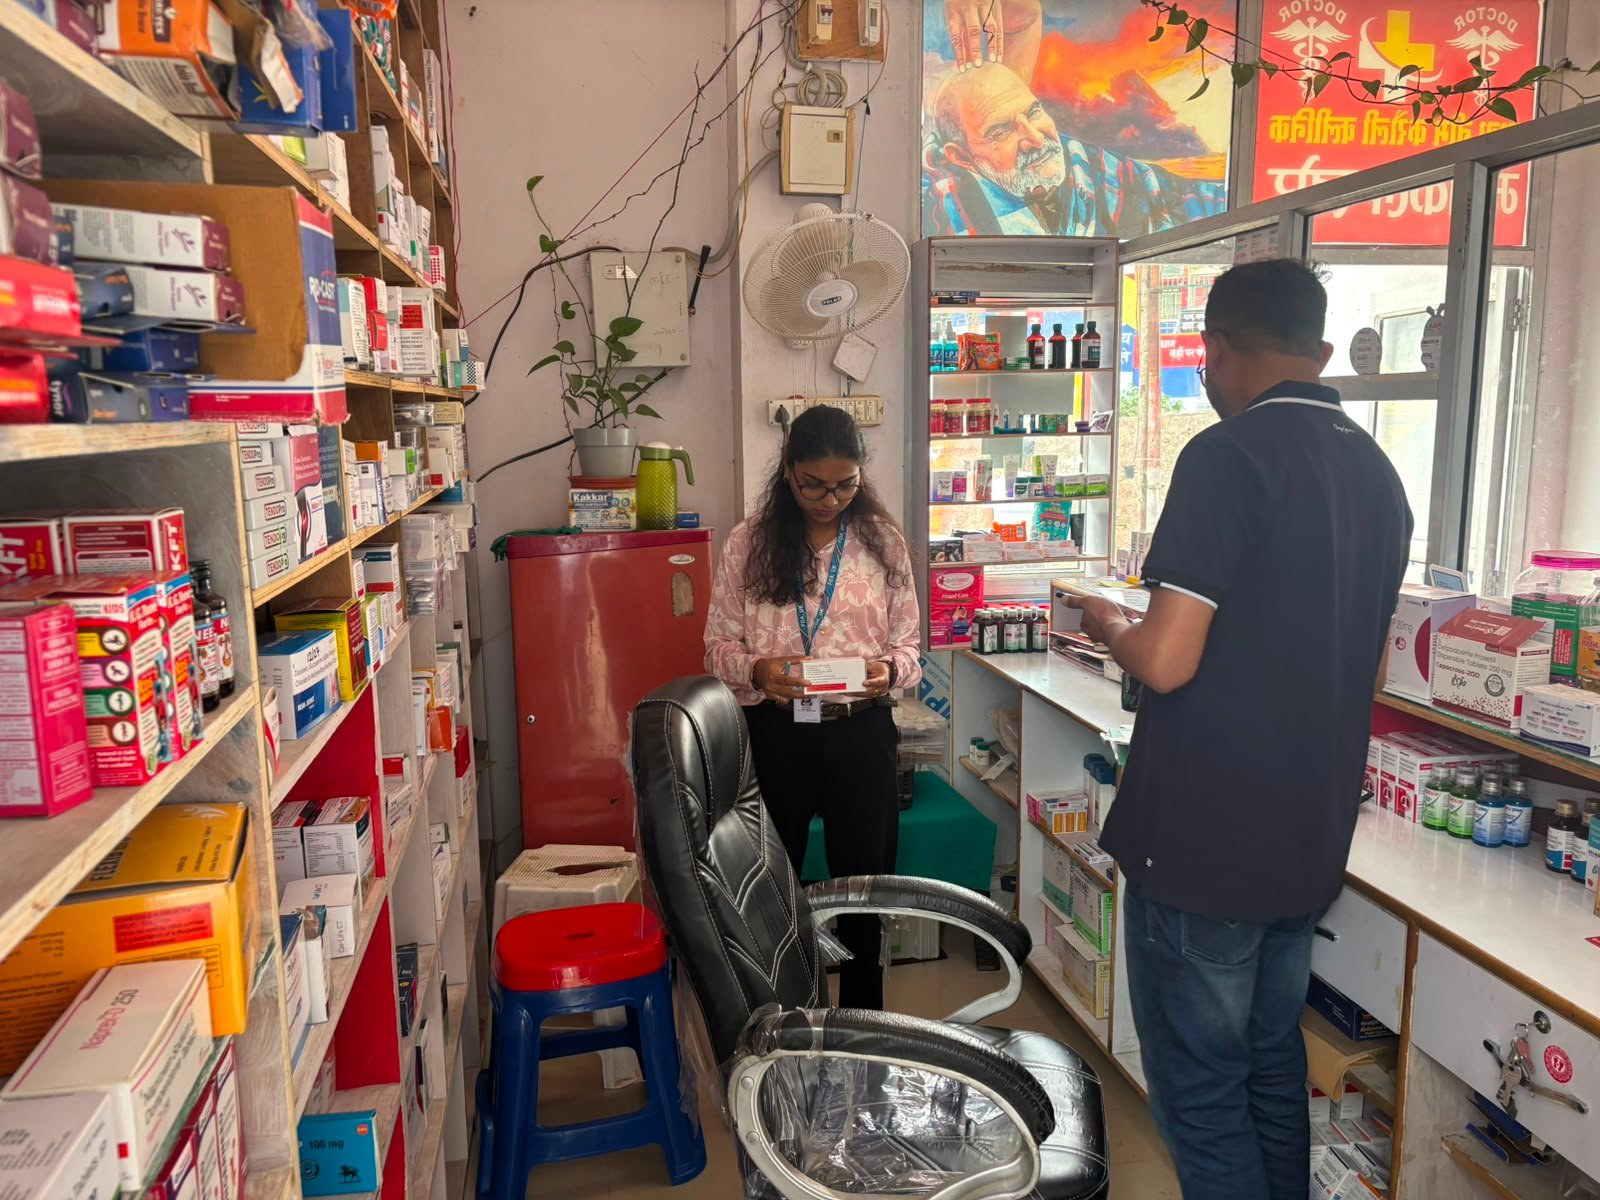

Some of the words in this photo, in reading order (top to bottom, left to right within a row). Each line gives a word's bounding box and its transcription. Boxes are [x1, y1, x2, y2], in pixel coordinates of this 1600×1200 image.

[573, 493, 608, 502] Kakkar
[103, 604, 125, 614] KIDS
[1489, 665, 1500, 673] 200
[1501, 669, 1512, 678] mg
[309, 1140, 325, 1149] 100
[328, 1140, 344, 1150] mg
